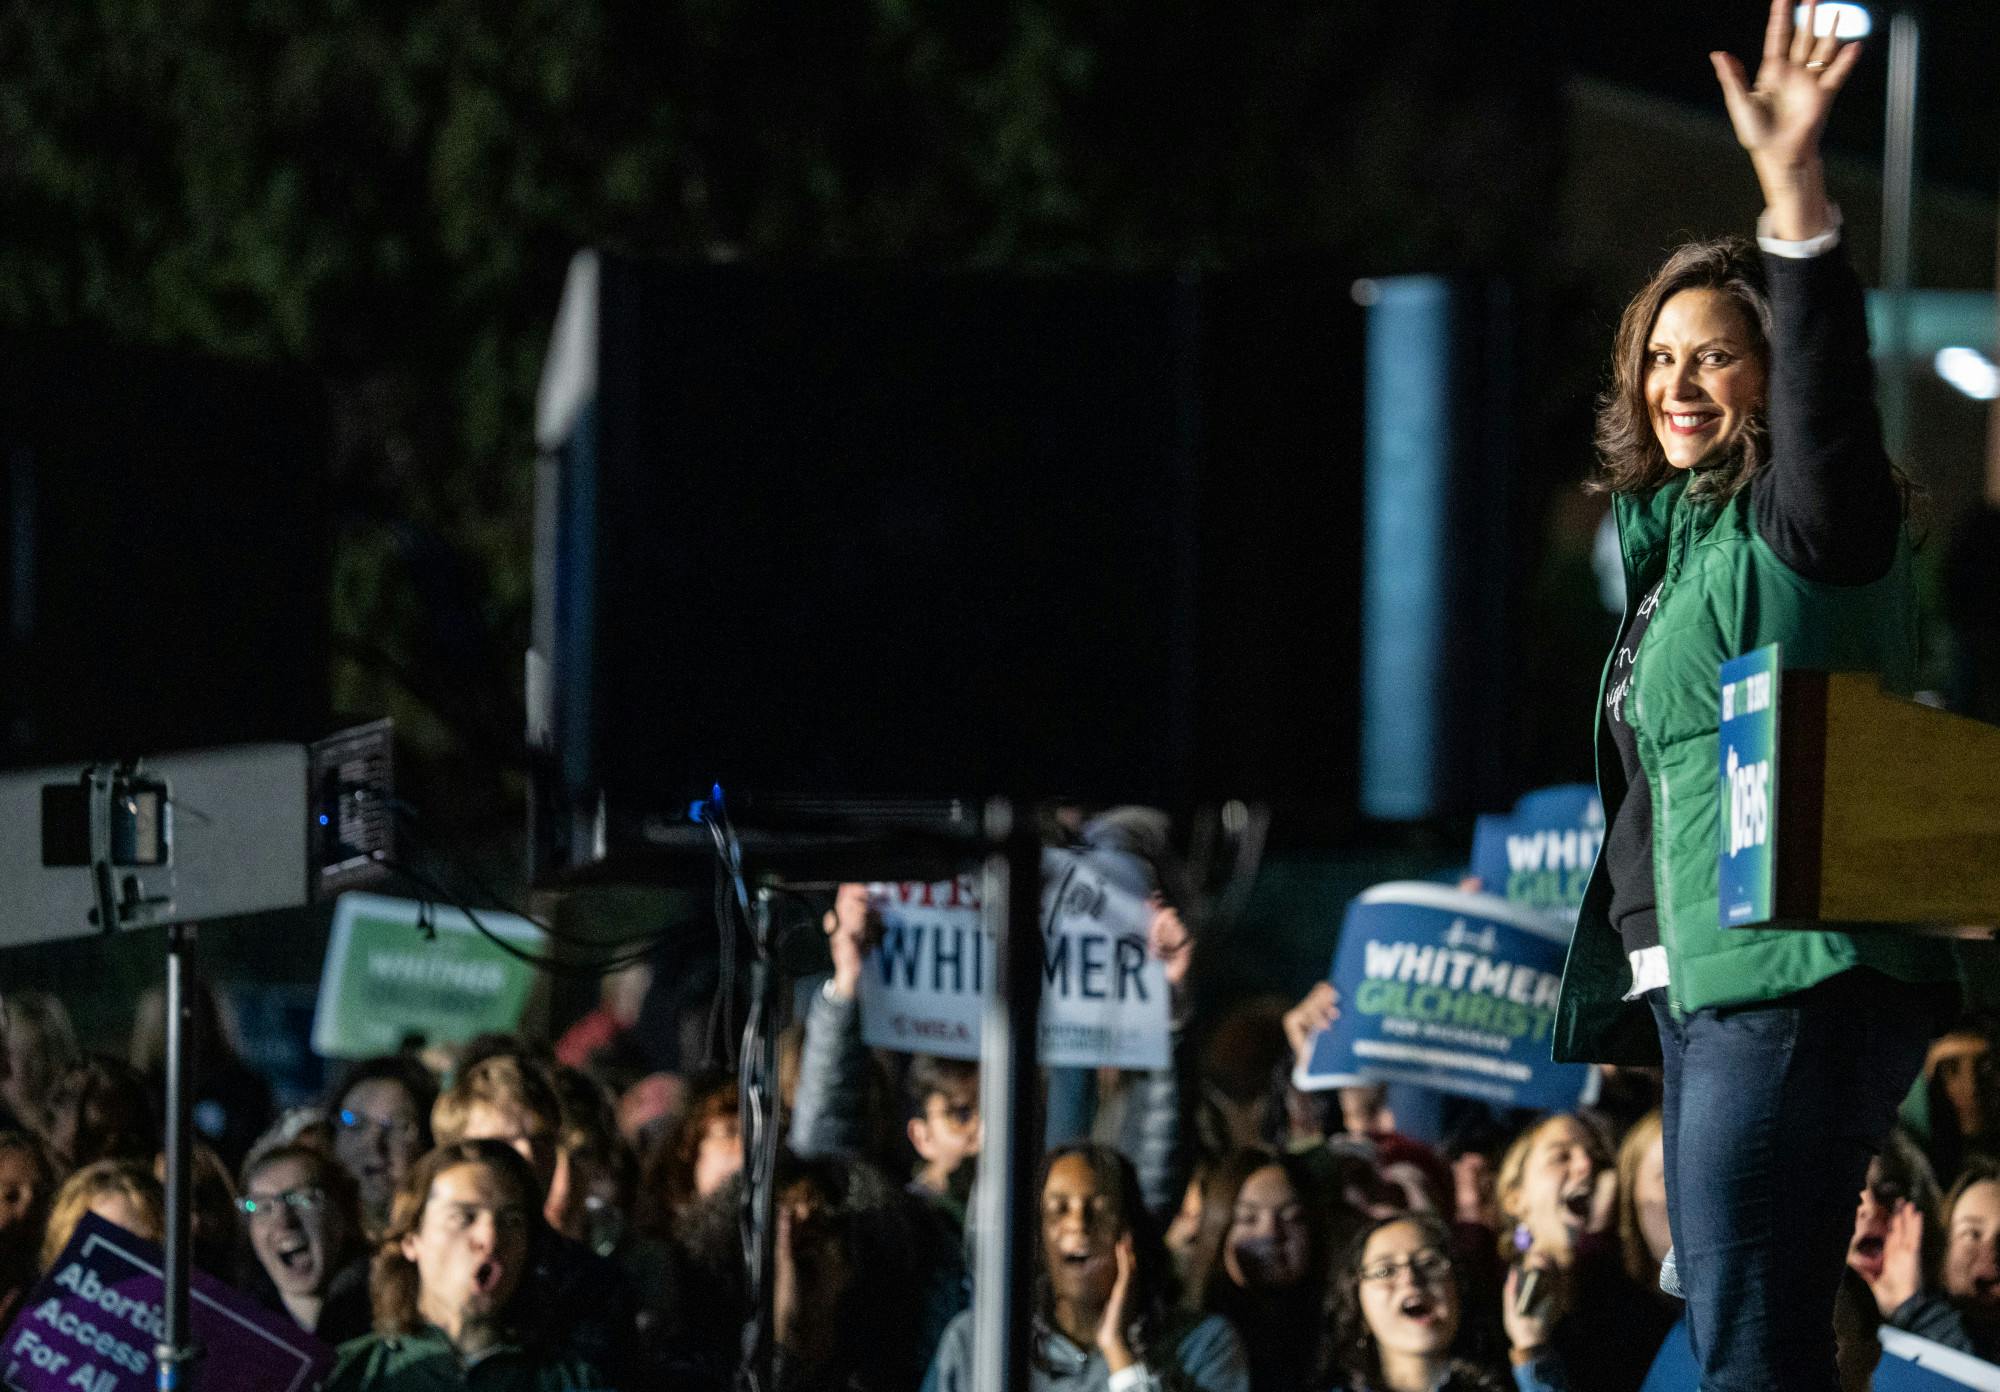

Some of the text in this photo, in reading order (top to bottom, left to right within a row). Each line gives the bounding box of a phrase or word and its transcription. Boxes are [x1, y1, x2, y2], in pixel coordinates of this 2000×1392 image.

[880, 921, 1149, 1002] WHIMER
[12, 1328, 70, 1375] For
[33, 1298, 149, 1375] Access
